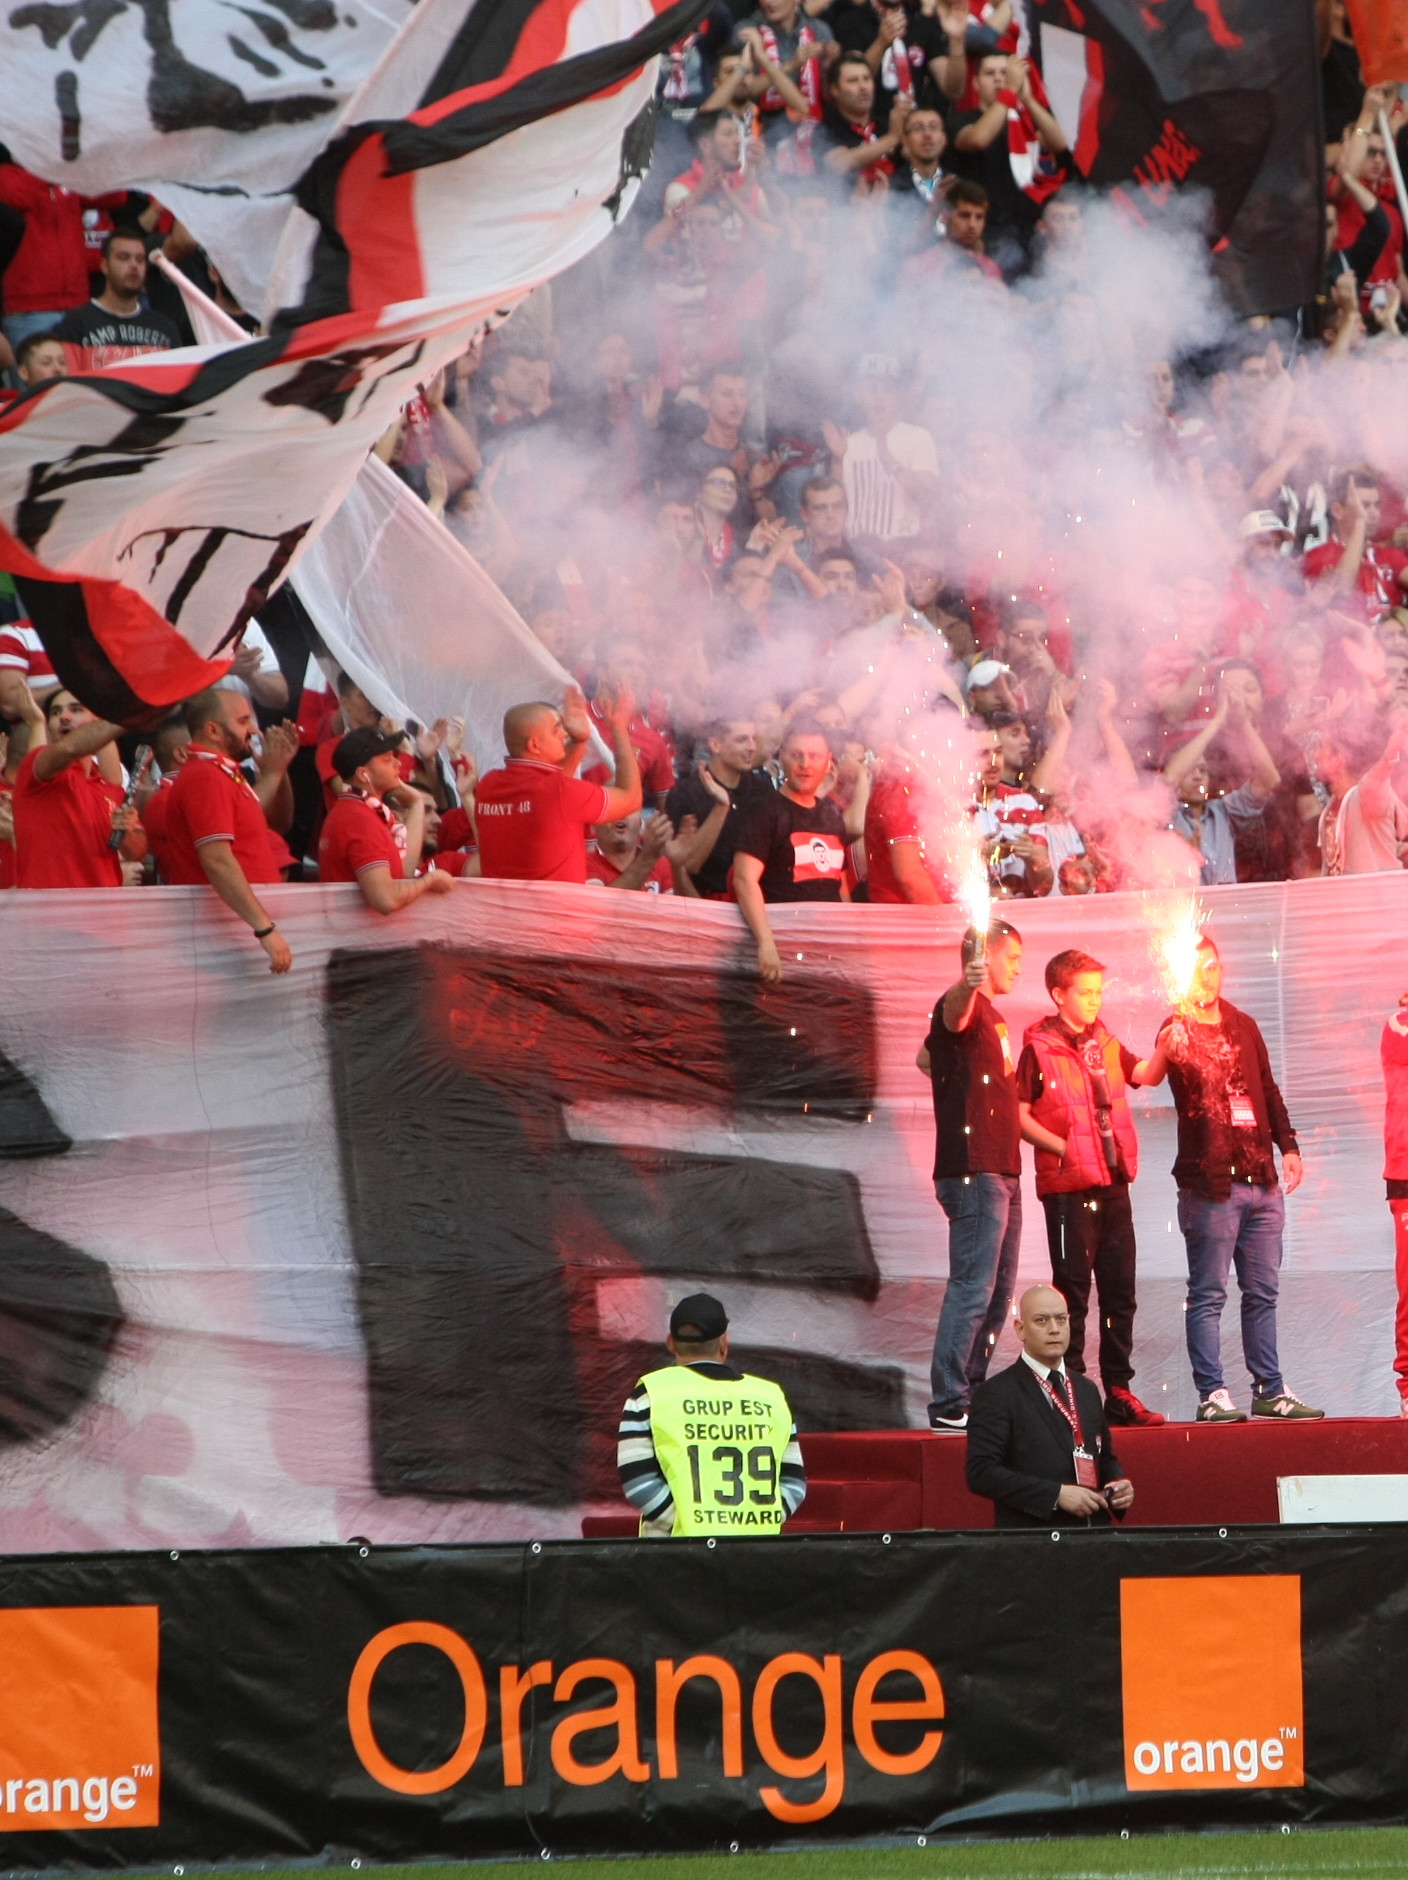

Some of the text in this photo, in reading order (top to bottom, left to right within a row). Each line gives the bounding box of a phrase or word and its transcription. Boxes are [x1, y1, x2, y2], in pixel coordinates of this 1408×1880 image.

[478, 800, 531, 816] FRONT 48
[682, 1399, 773, 1418] GRUP EST
[684, 1423, 774, 1441] SECURITY
[686, 1445, 777, 1506] 139
[693, 1509, 782, 1525] STEWARD
[347, 1620, 946, 1824] Orange
[1133, 1737, 1285, 1783] orange
[0, 1775, 138, 1823] range
